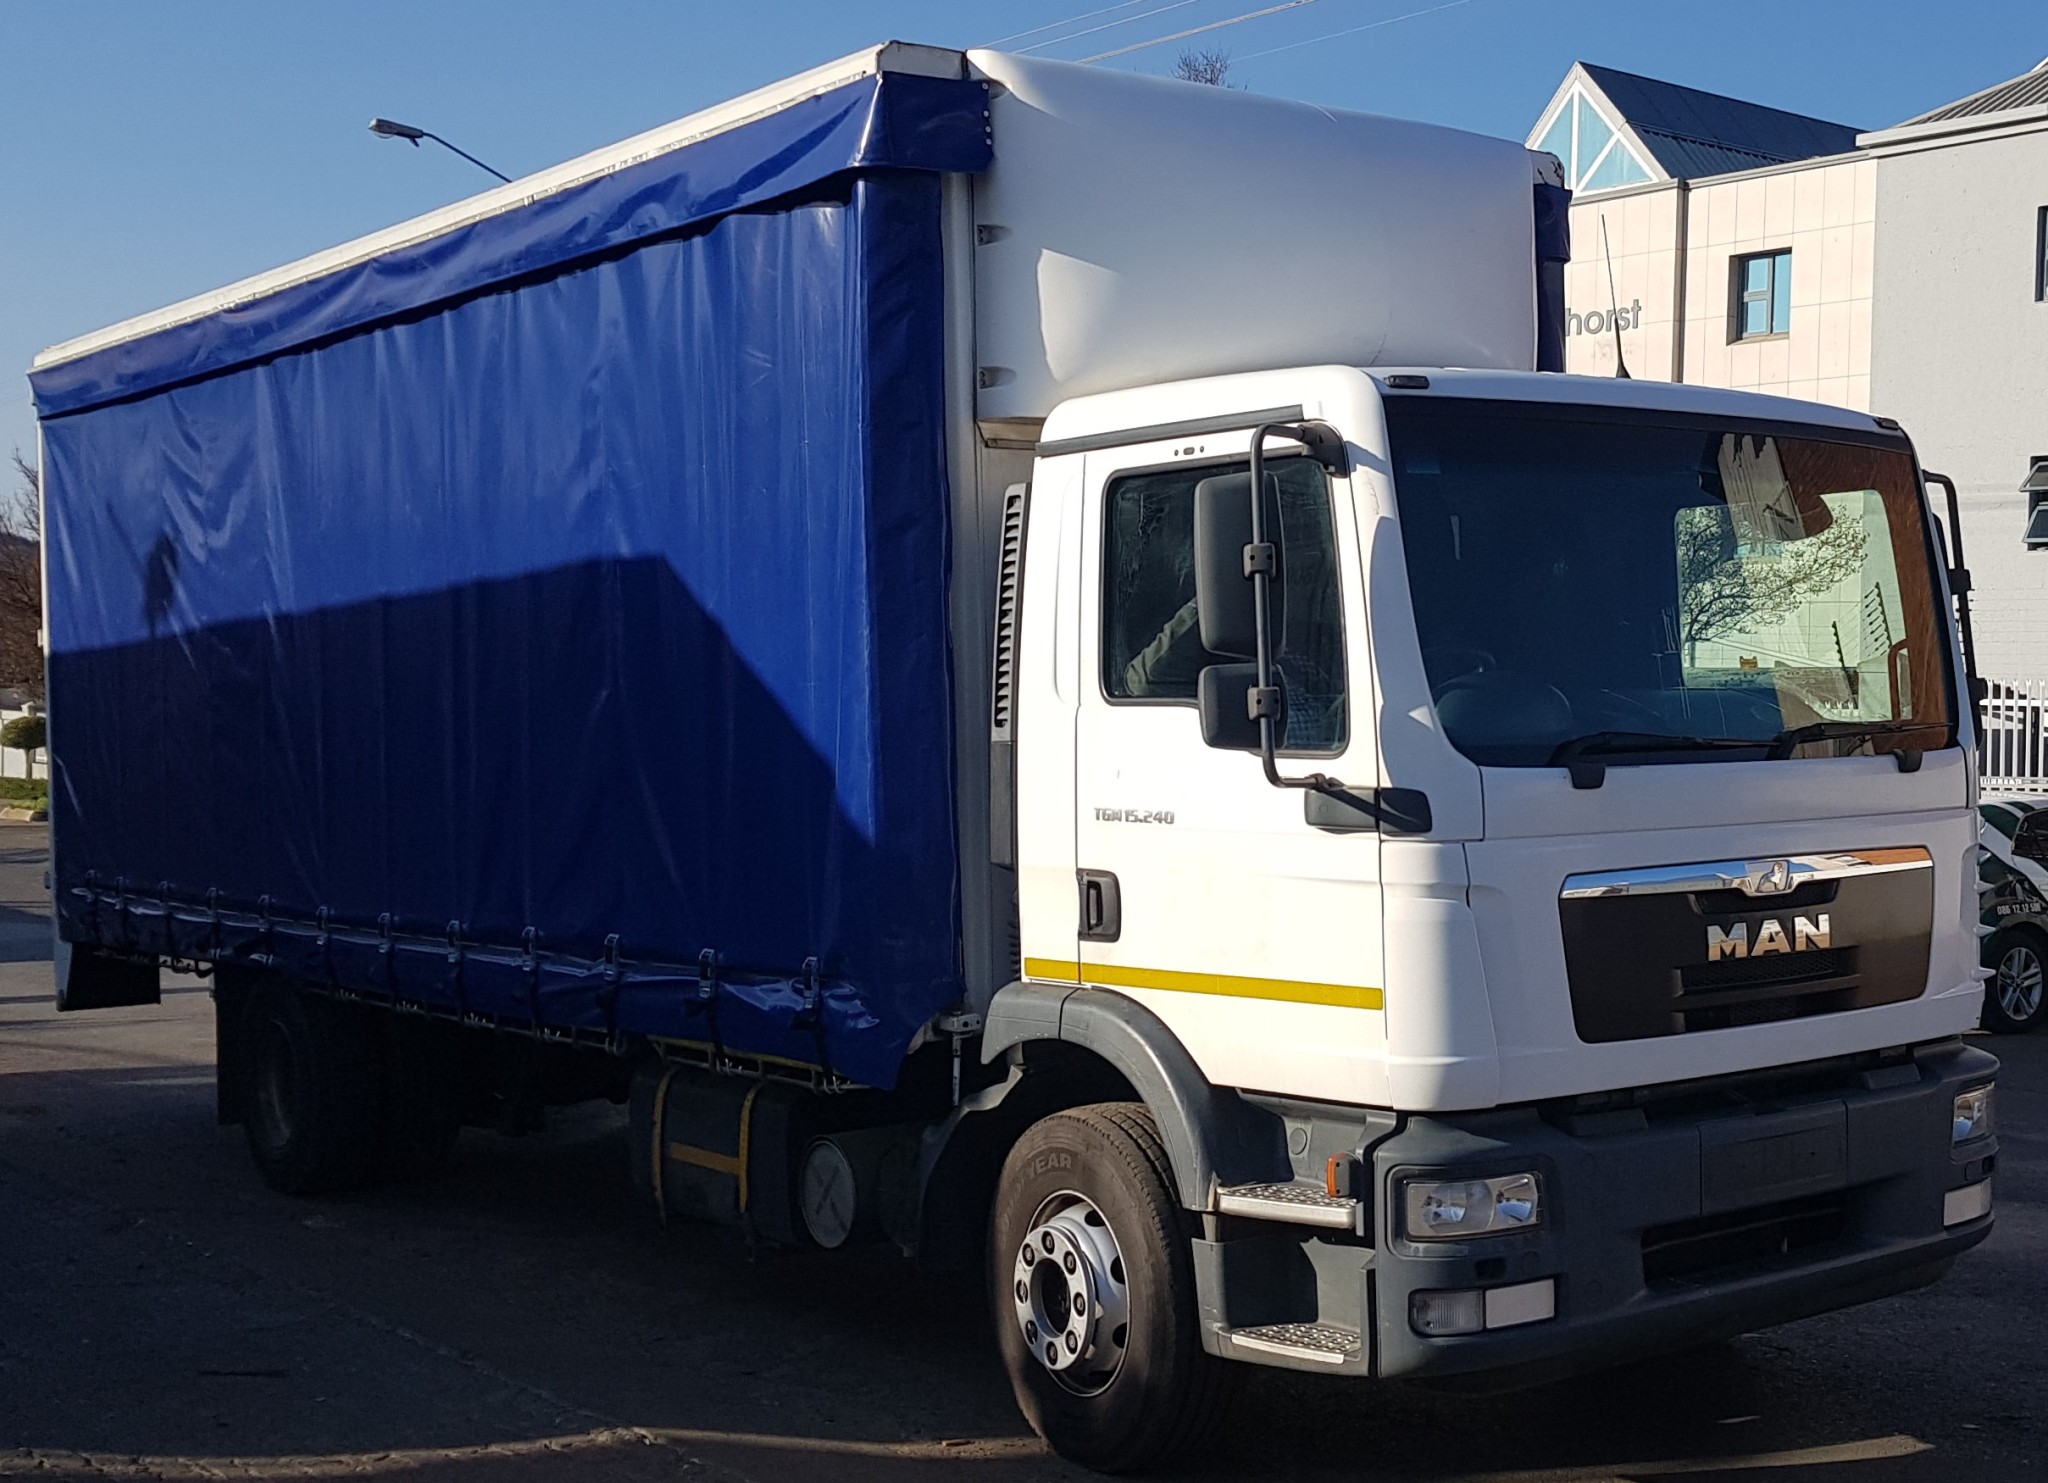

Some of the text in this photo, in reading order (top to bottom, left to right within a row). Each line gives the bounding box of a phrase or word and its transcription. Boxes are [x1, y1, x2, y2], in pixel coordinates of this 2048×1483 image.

[1565, 299, 1642, 337] horst
[1124, 809, 1175, 825] 15.240
[2012, 904, 2021, 914] 12
[2021, 903, 2030, 913] 12
[1706, 914, 1831, 962] MAN
